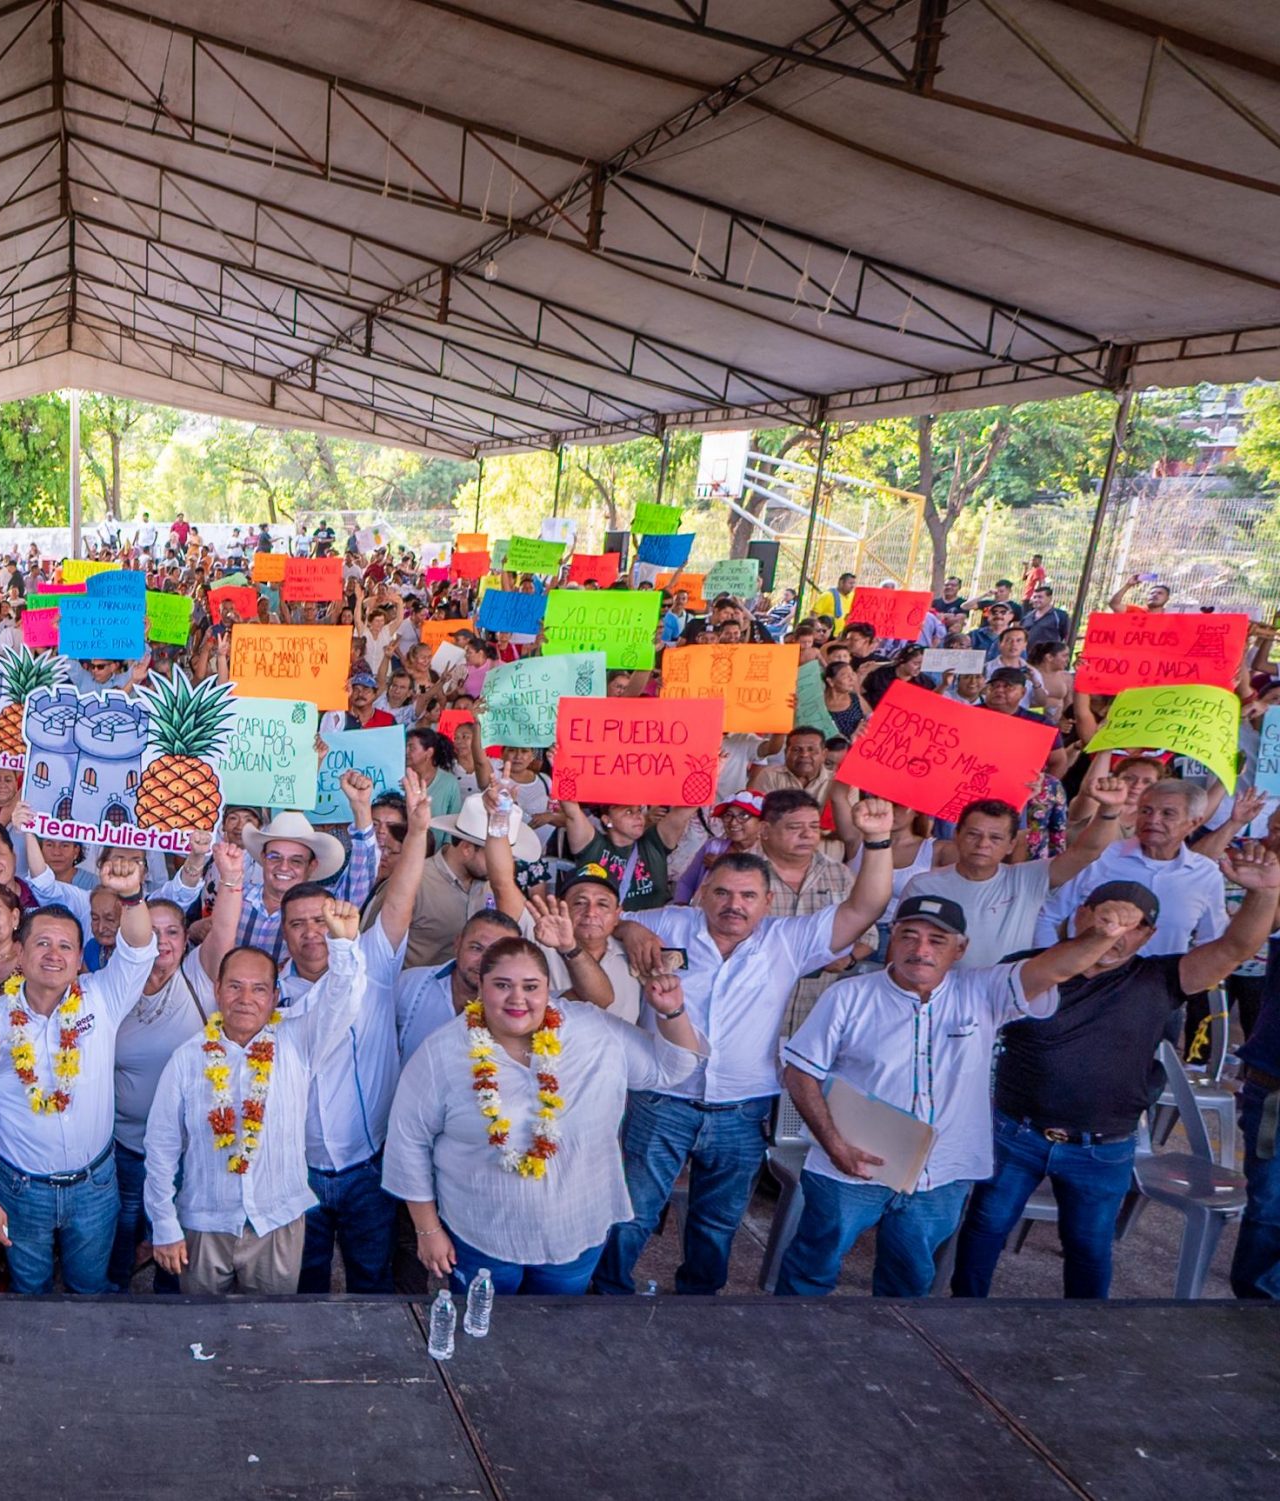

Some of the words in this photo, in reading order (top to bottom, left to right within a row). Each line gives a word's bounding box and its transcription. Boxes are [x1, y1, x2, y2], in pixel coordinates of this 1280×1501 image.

[562, 606, 586, 624] YO
[92, 628, 104, 638] DE
[549, 626, 607, 642] TORRES
[1088, 631, 1116, 645] CON
[1124, 631, 1180, 647] CARLOS
[72, 640, 108, 650] TORRES
[235, 637, 274, 651] CARLOS
[277, 636, 328, 650] TORRES
[234, 652, 248, 665] DE
[254, 652, 267, 665] LA
[273, 652, 305, 665] MANO
[309, 652, 329, 665] CON
[233, 666, 245, 678] EL
[256, 666, 301, 678] PUEBLO
[1081, 656, 1130, 676] TODO
[1138, 660, 1151, 677] O
[1156, 661, 1201, 681] NADA
[510, 674, 532, 690] VE!
[500, 690, 549, 707] SIENTE!
[736, 686, 772, 704] TODO!
[236, 717, 287, 738] CARLOS
[569, 718, 594, 743] EL
[603, 719, 689, 746] PUEBLO
[885, 702, 960, 749] TORRES
[263, 736, 296, 757] POR
[858, 738, 908, 771] GALLO
[923, 744, 948, 766] ES
[326, 750, 354, 769] CON
[571, 754, 606, 776] TE
[610, 752, 676, 777] APOYA
[24, 814, 193, 853] #TeamJulietaLZ
